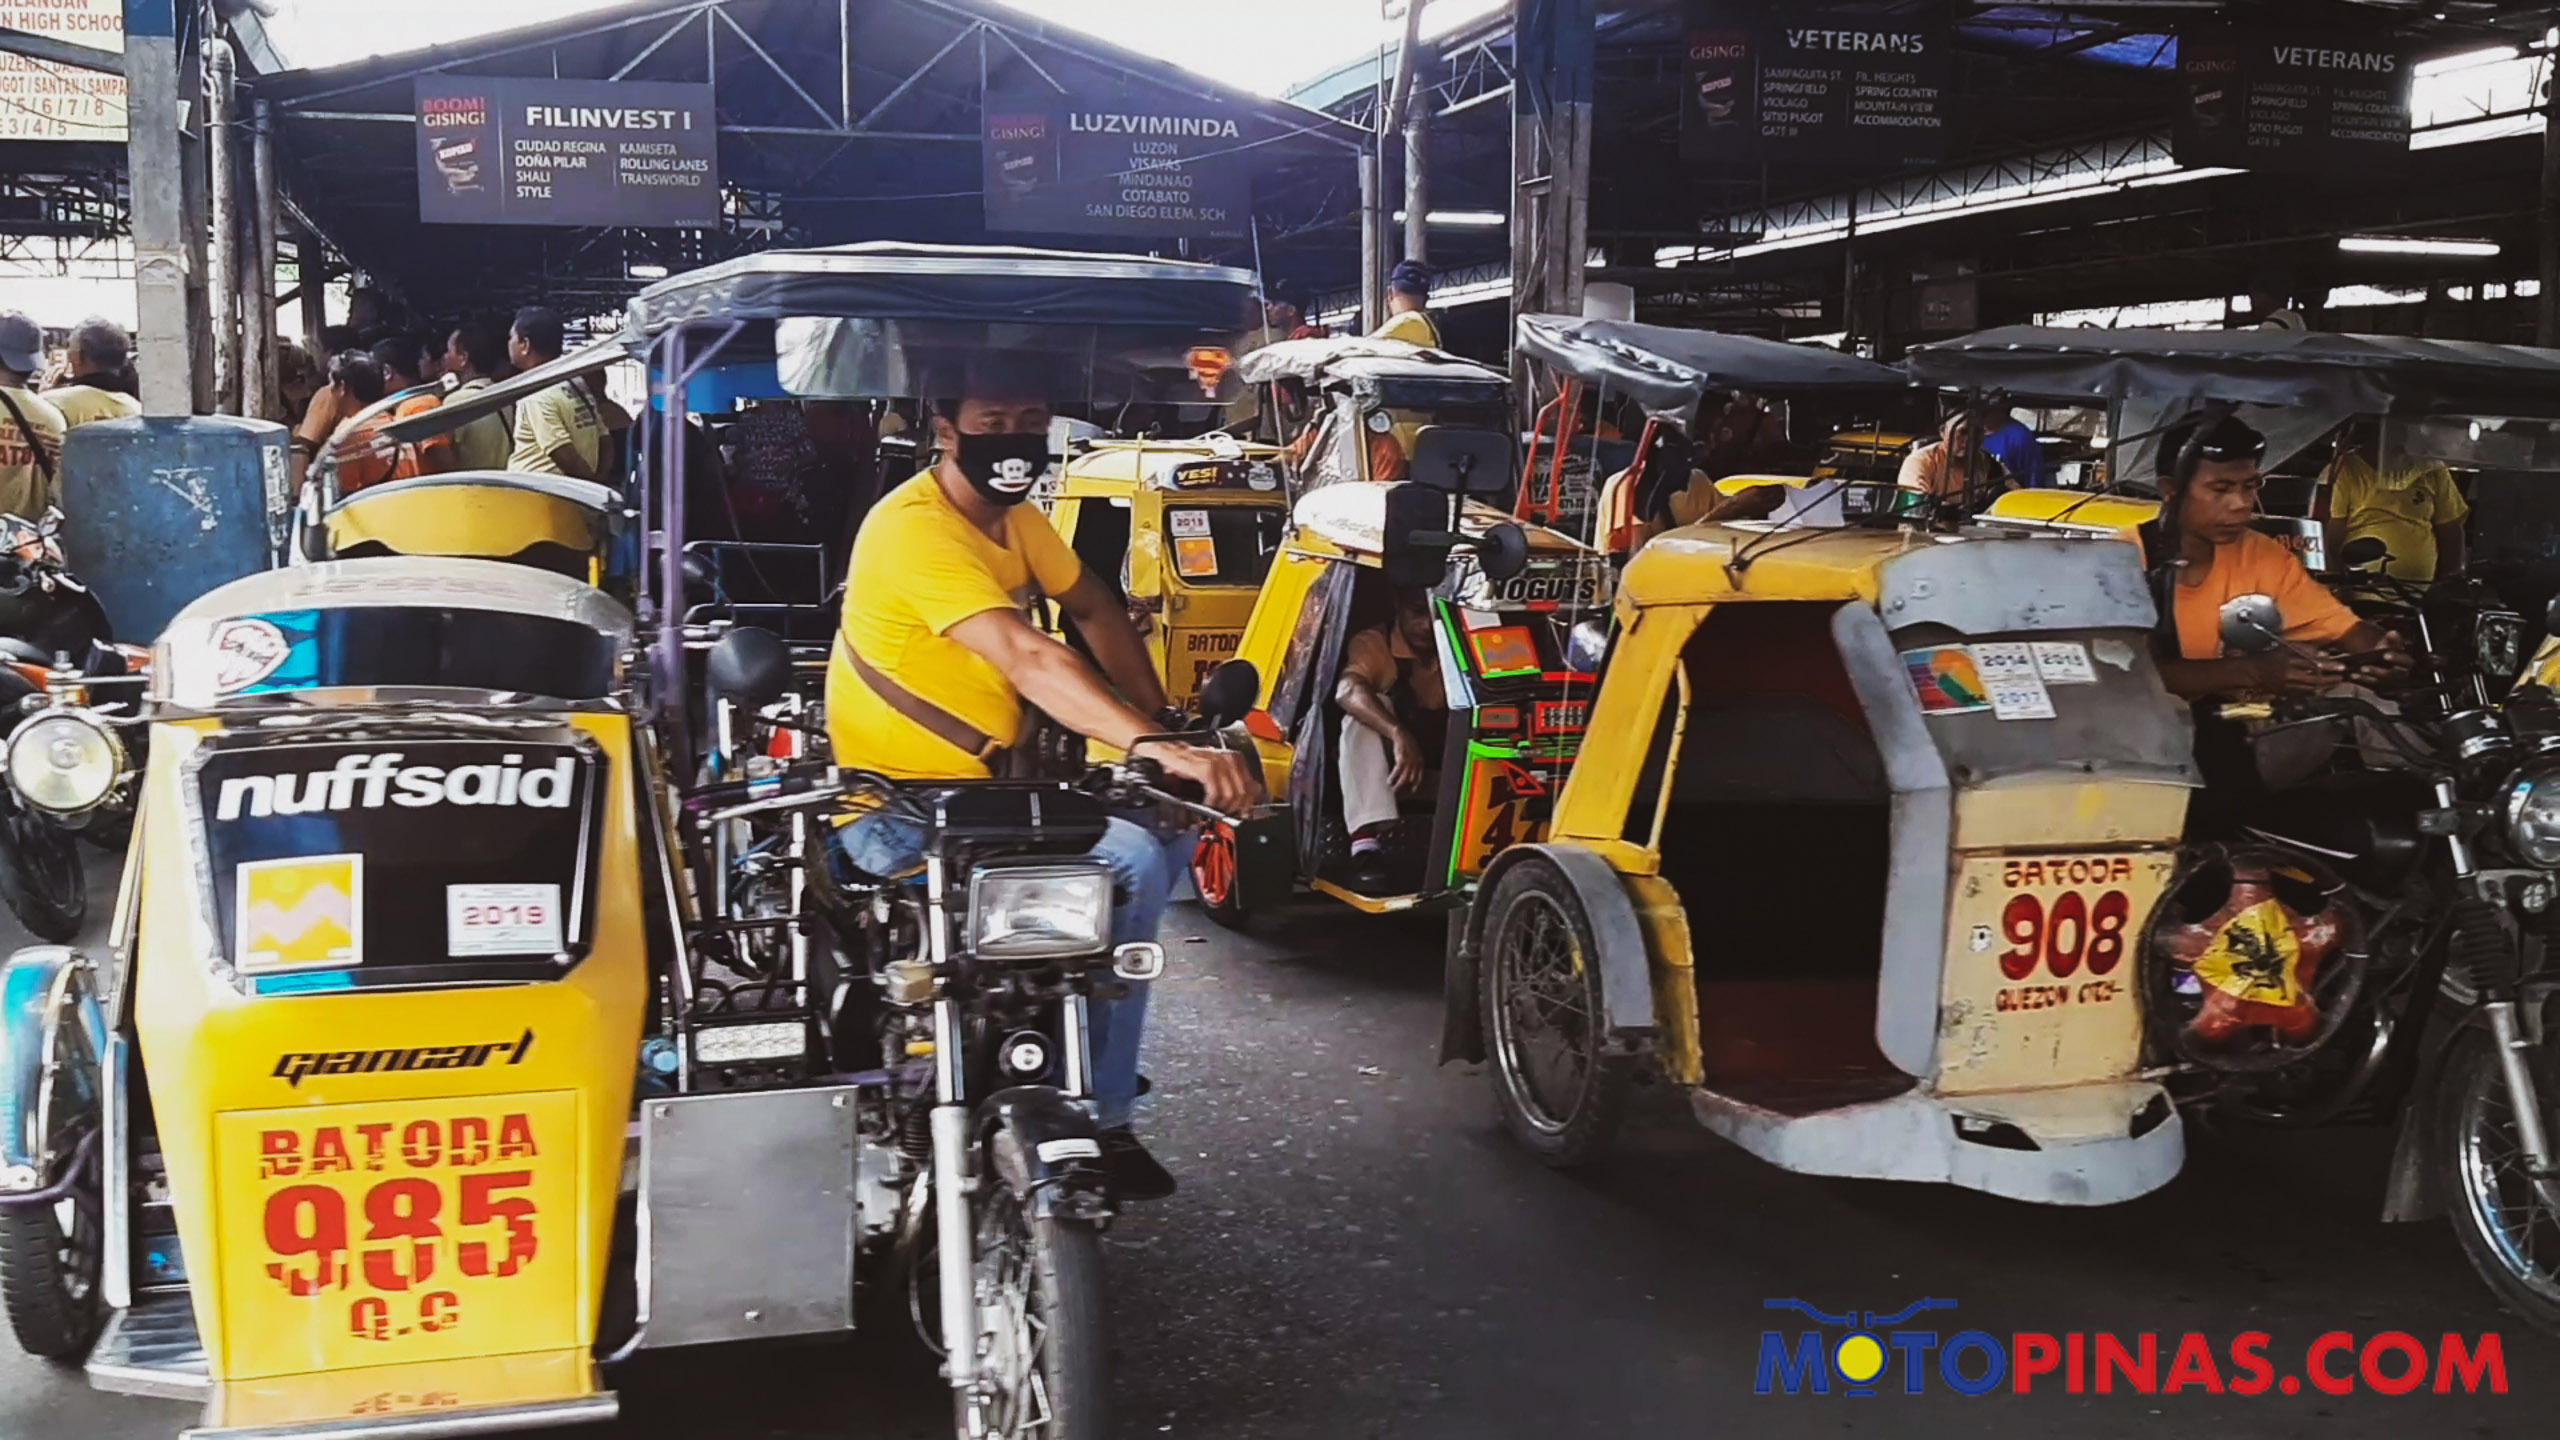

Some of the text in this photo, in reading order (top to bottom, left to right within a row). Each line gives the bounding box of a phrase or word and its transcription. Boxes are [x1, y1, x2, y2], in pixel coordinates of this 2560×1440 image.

[19, 12, 61, 30] HIGH
[1786, 29, 1924, 54] VETERANS
[1690, 45, 1745, 59] GISING!
[2273, 46, 2395, 73] VETERANS
[1763, 83, 1828, 95] SPRINGFIELD
[1855, 86, 1939, 99] SPRING COUNTRY
[424, 96, 485, 112] BOOM!
[423, 111, 485, 127] GISING!
[526, 106, 676, 129] FILINVEST
[1070, 113, 1239, 138] LUZVIMINDA
[515, 140, 607, 153] CIUDAD REGINA
[620, 143, 677, 155] KAMISETA
[1133, 142, 1178, 155] LUZON
[515, 154, 587, 168] DOÑA PILAR
[620, 158, 709, 172] ROLLING LANES
[1129, 157, 1181, 171] VISAYAS
[516, 171, 551, 183] SHALI
[621, 172, 700, 186] TRANSWORLD
[1119, 174, 1192, 188] MINDANAO
[516, 186, 552, 198] STYLE
[1122, 189, 1190, 203] COTABATO
[1086, 204, 1113, 217] SAN
[1116, 205, 1157, 218] DIEGO
[1188, 634, 1240, 652] BATOD
[216, 753, 575, 820] nuffsaid
[2003, 858, 2132, 888] BATODA
[462, 904, 547, 926] 2019
[1999, 890, 2130, 980] 908
[259, 1113, 539, 1180] BATODA
[264, 1169, 539, 1297] 985
